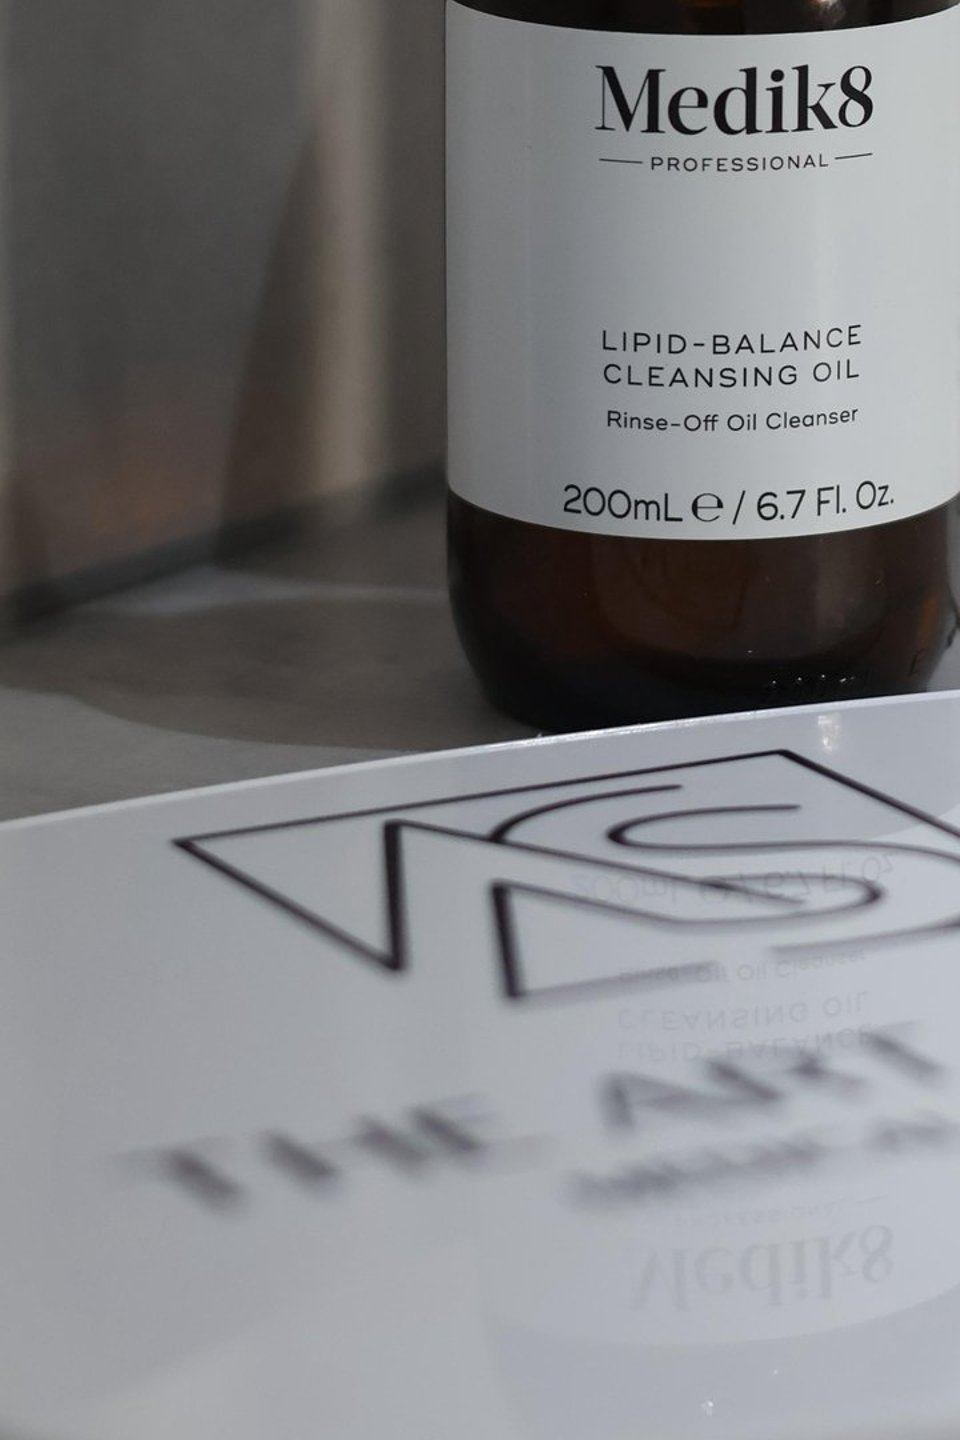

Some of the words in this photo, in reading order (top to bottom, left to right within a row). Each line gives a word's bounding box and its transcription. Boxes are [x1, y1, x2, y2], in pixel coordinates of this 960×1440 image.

[594, 64, 874, 136] Medik8
[650, 153, 829, 172] PROFESSIONAL
[601, 324, 862, 355] LIPID-BALANCE
[603, 363, 798, 388] CLEANSING
[812, 358, 860, 383] OIL
[606, 409, 719, 432] Rinse-Off
[726, 412, 757, 432] Oil
[765, 408, 859, 431] Cleanser
[563, 484, 683, 522] 200mL
[756, 489, 806, 521] 6.7
[816, 484, 847, 516] Fl.
[855, 480, 895, 510] Oz.
[120, 1094, 545, 1222] THE
[592, 1020, 948, 1133] ART
